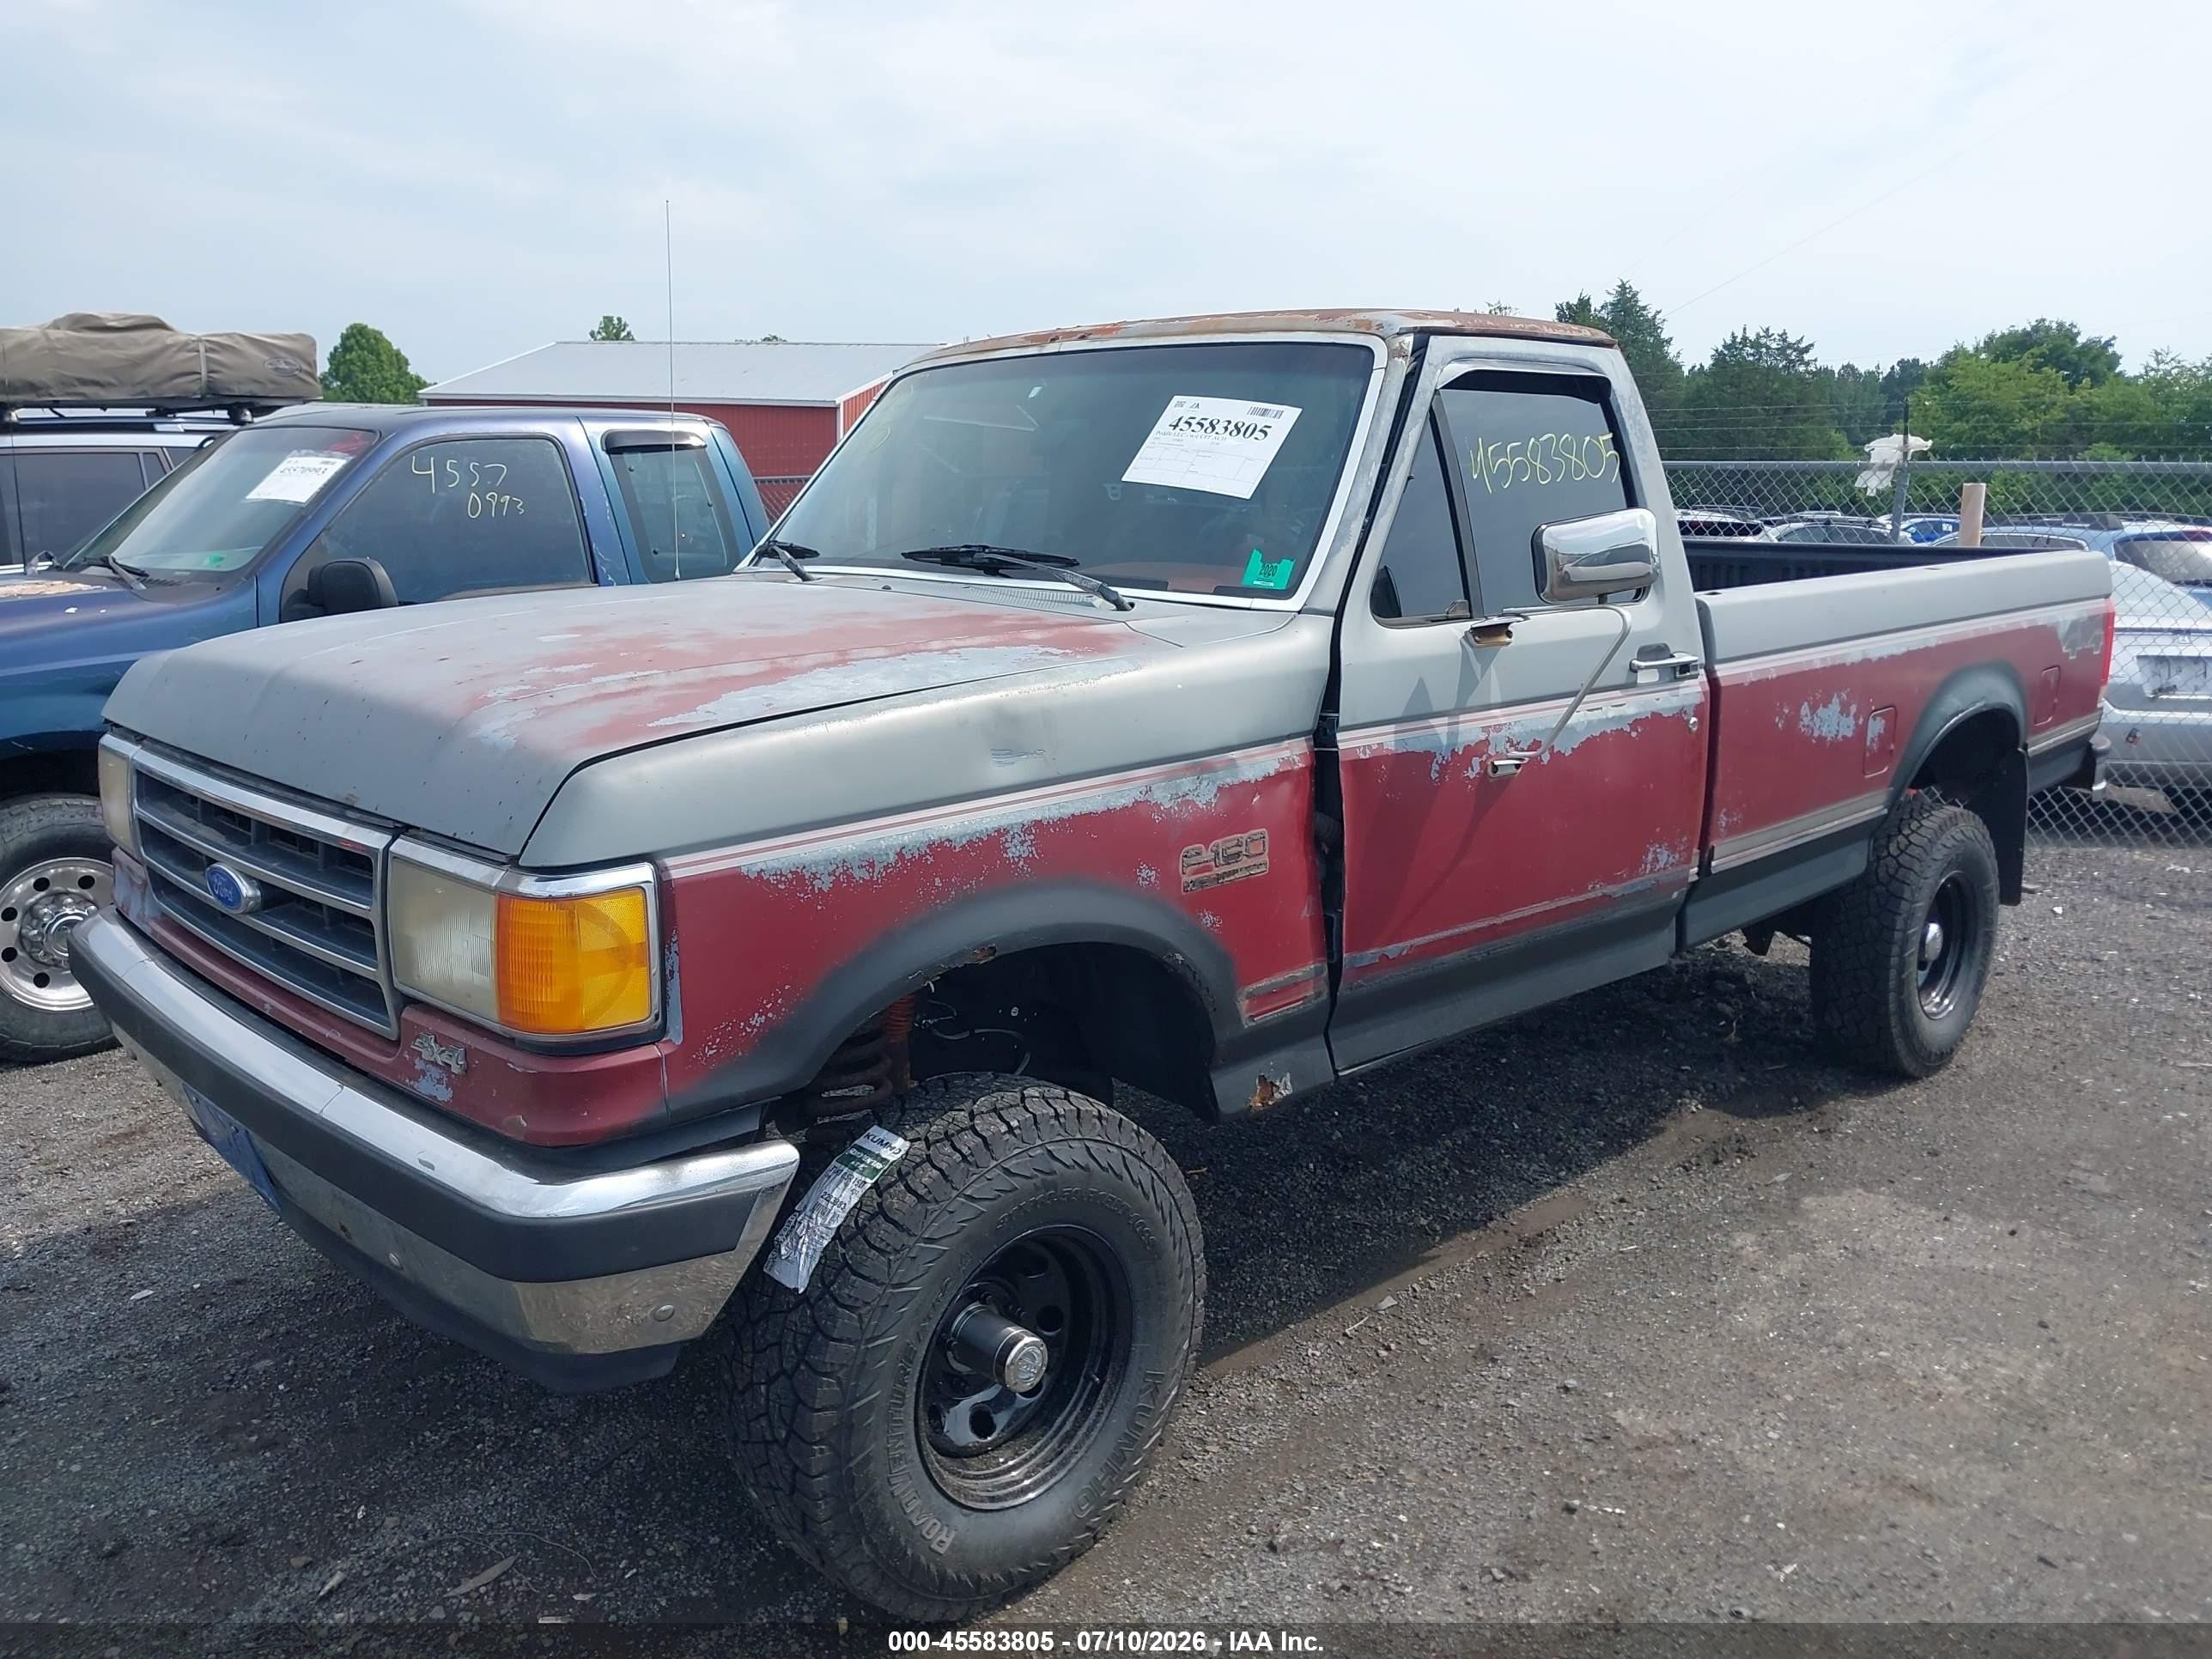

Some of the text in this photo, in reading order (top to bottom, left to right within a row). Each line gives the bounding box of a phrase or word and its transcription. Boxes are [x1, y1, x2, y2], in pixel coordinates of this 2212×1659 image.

[1168, 415, 1273, 441] 45583805
[411, 455, 507, 495] 4557
[1469, 433, 1620, 495] 45583805
[467, 492, 526, 519] 0993
[211, 872, 235, 902] Ford
[863, 1131, 902, 1156] KUMHO
[887, 1338, 957, 1555] ROADVENTURE
[1071, 1367, 1166, 1519] KUMHO
